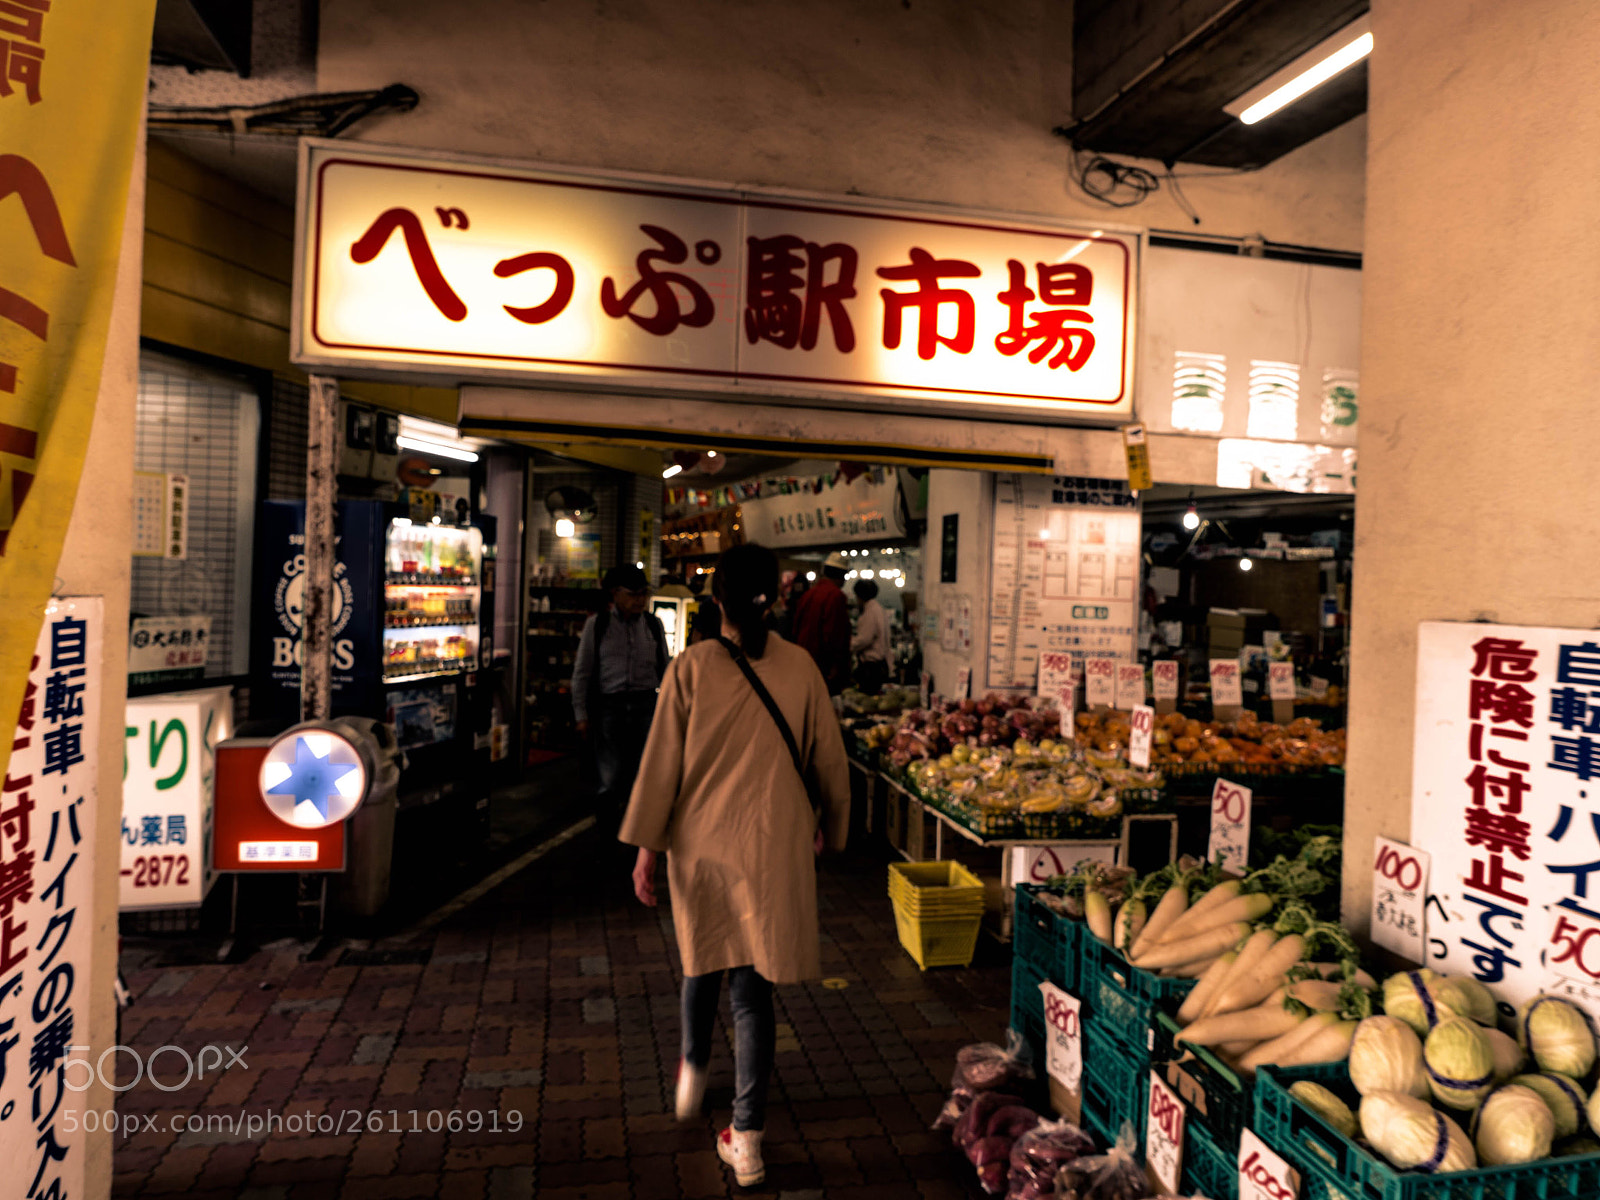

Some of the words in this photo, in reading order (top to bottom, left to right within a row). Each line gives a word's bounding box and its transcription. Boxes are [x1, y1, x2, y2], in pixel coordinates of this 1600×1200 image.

[351, 206, 1095, 371] べっぷ駅市場
[283, 554, 347, 579] COE
[272, 637, 354, 671] BS
[1213, 782, 1246, 824] 50
[1460, 635, 1540, 1017] 危険に付禁止です。
[1375, 844, 1422, 891] 100
